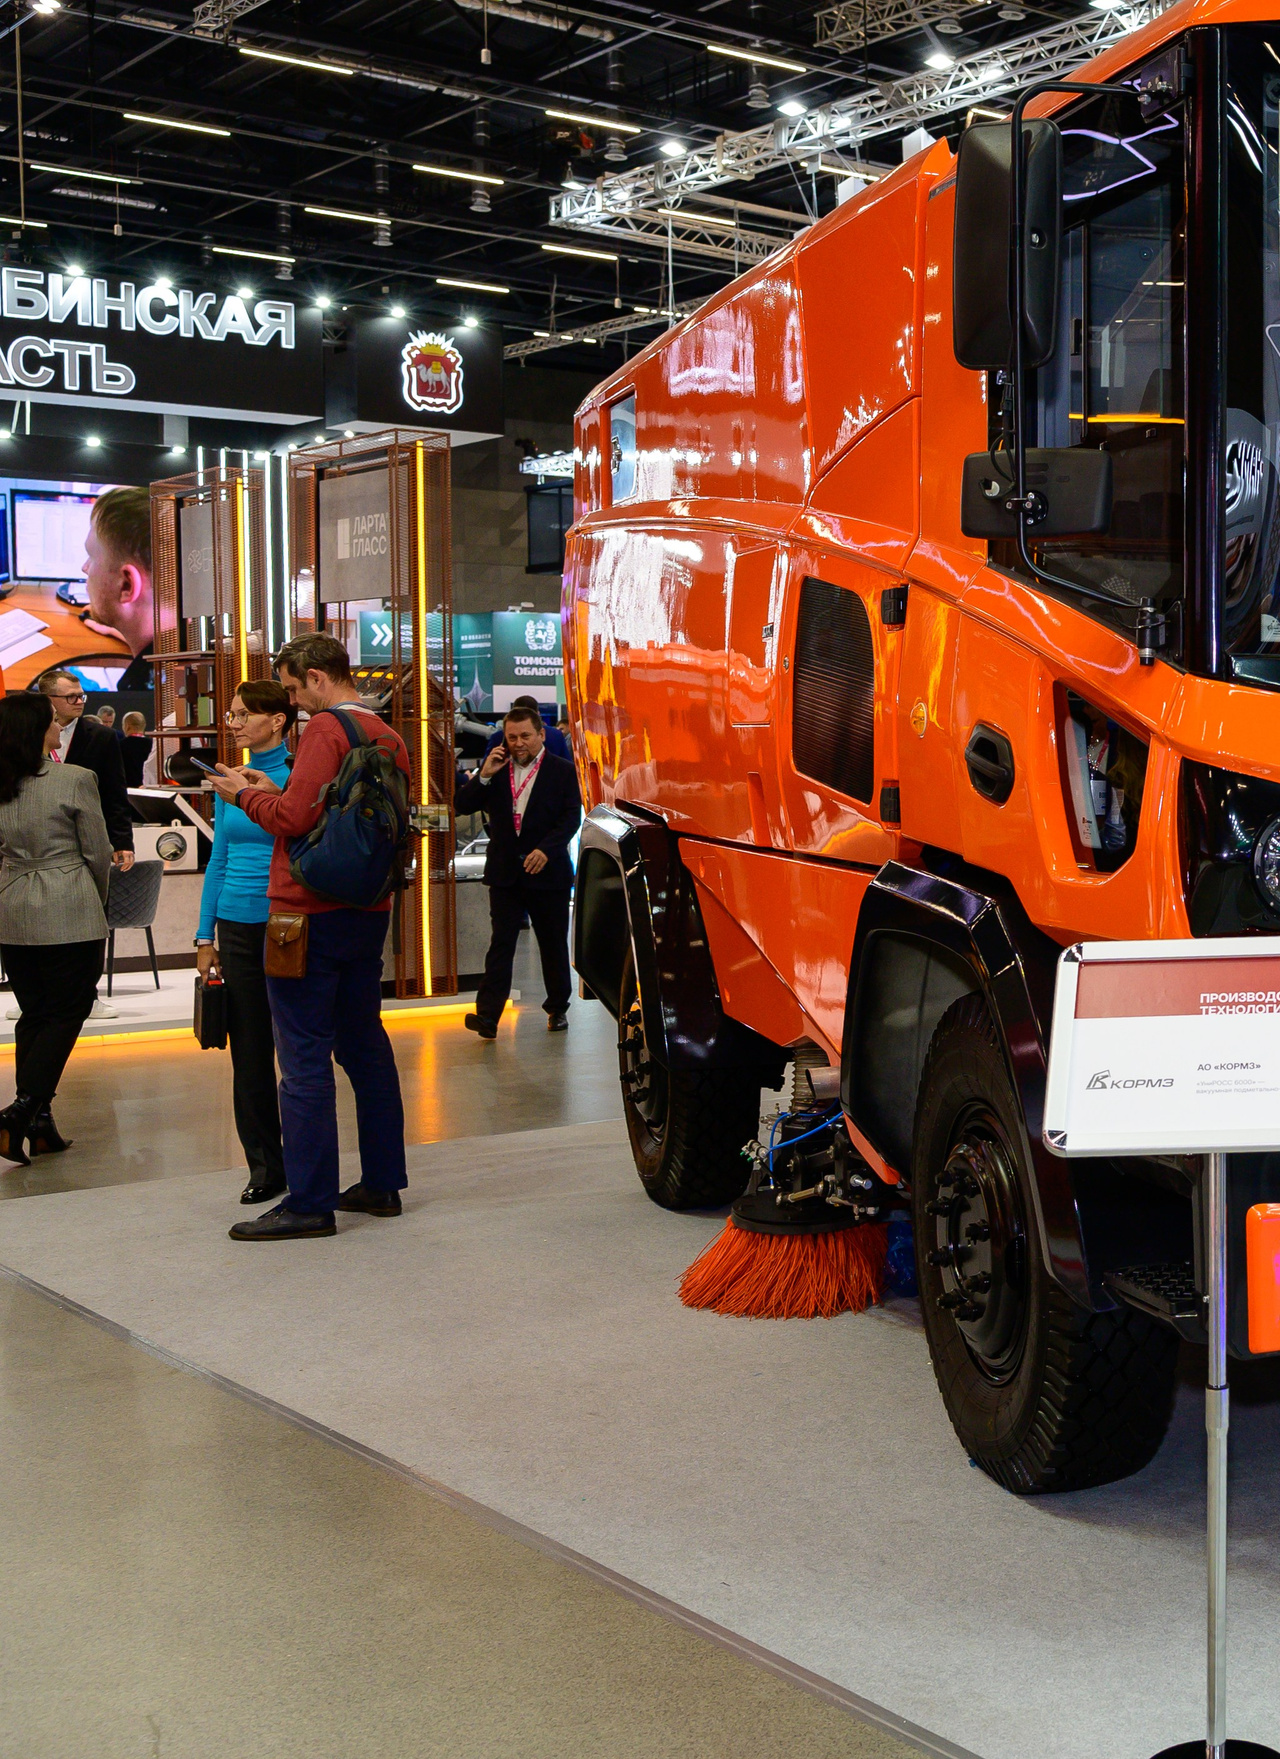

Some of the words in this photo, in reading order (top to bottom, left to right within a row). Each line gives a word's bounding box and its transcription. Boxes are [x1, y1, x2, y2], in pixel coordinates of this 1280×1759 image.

[0, 267, 295, 349] БИНСКАЯ
[353, 512, 387, 535] ЛАРТА
[352, 535, 387, 558] ГЛАСС
[1197, 1063, 1212, 1072] АО
[1213, 1062, 1261, 1071] «КОРМЗ»
[1110, 1078, 1175, 1089] КОРМЗ
